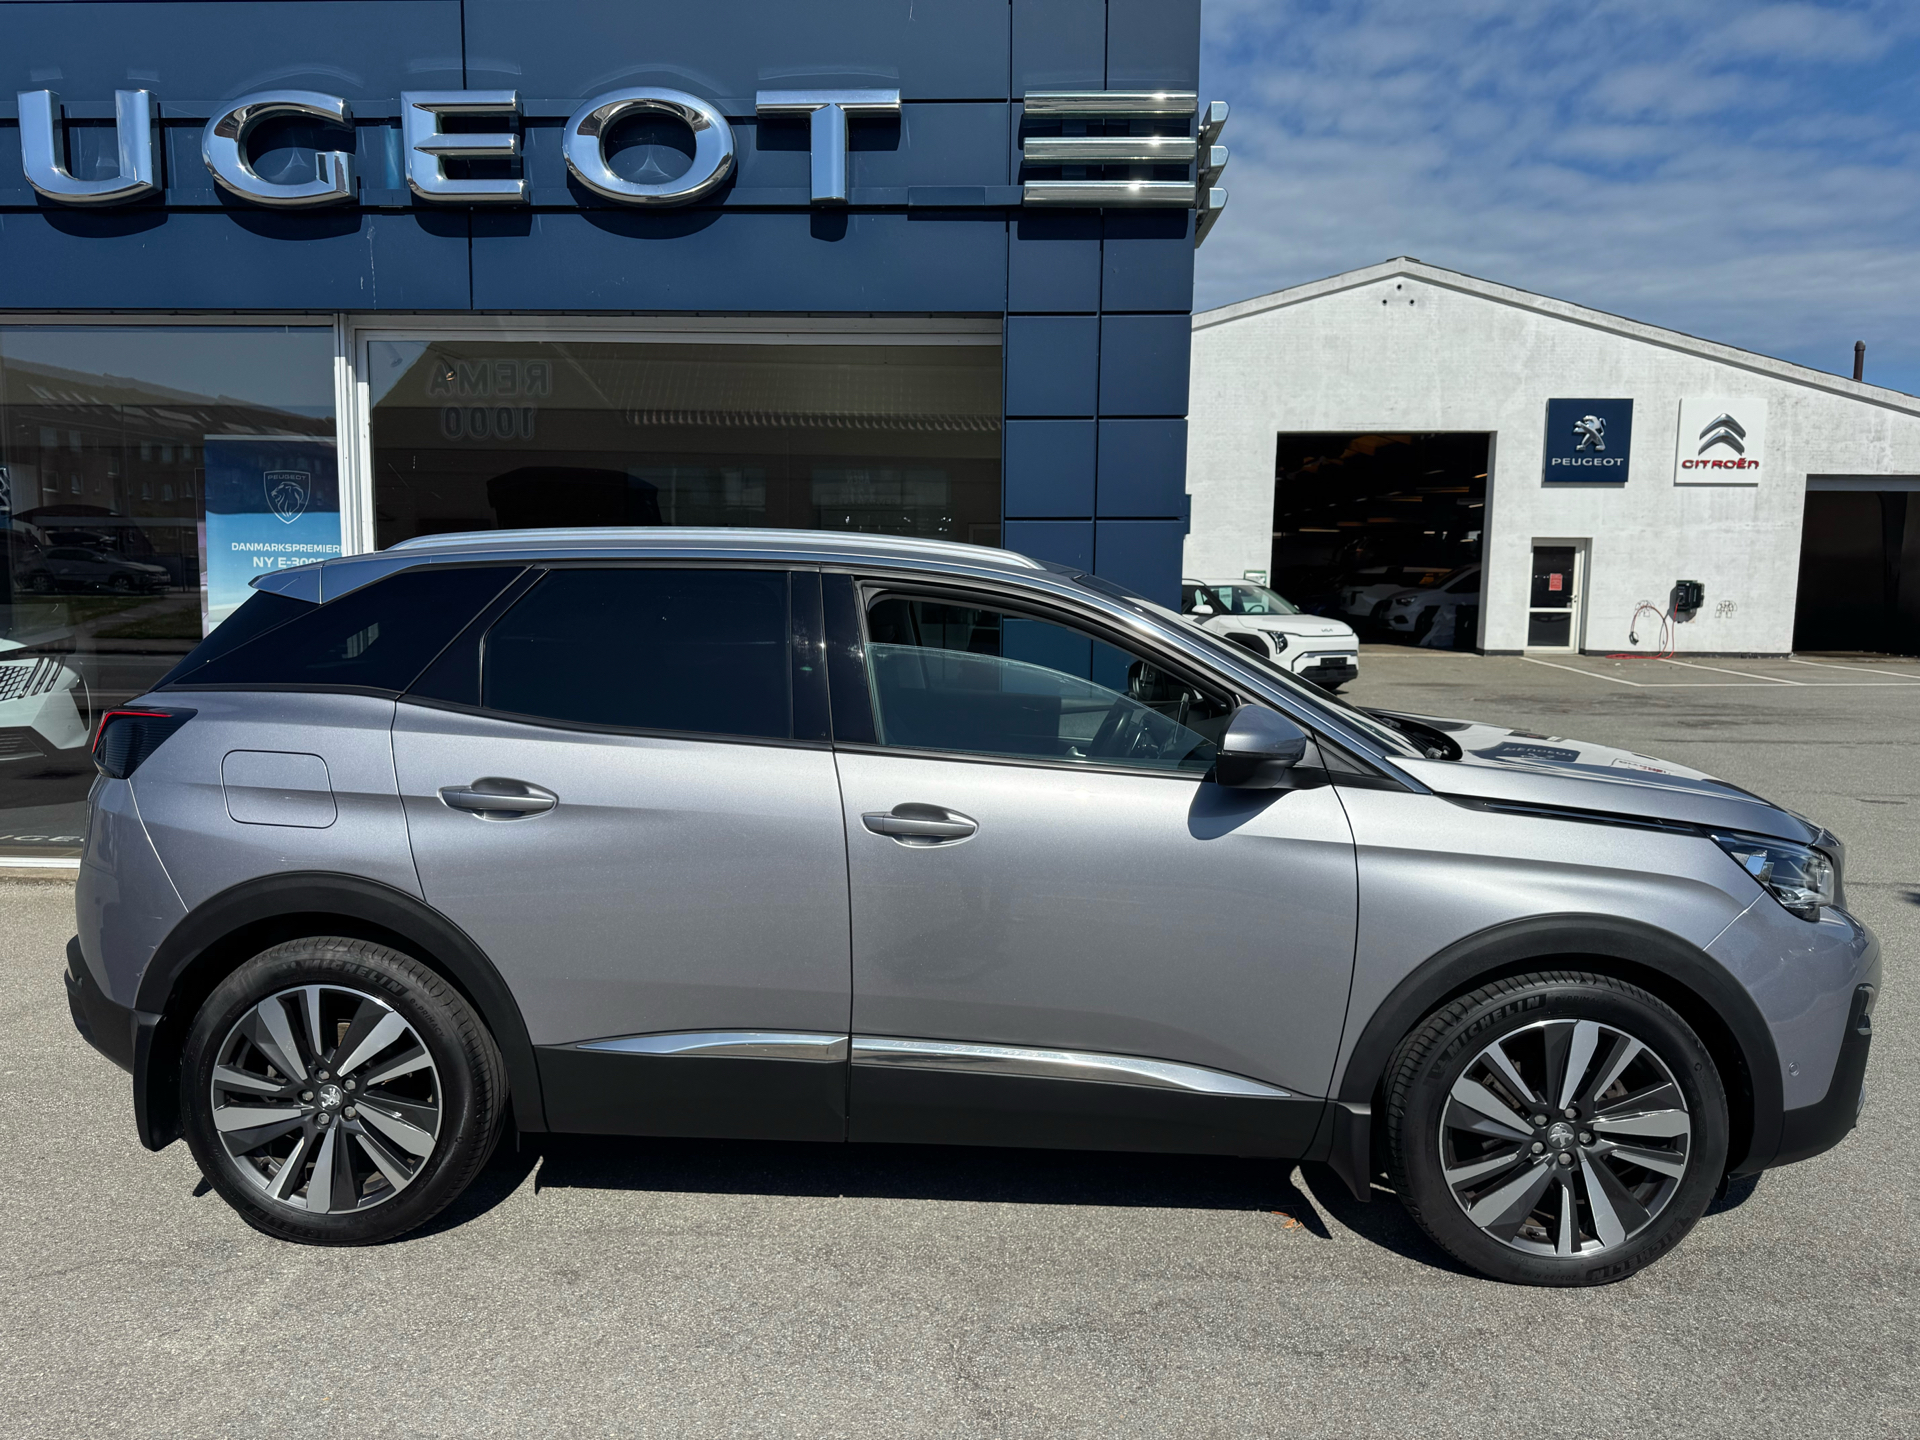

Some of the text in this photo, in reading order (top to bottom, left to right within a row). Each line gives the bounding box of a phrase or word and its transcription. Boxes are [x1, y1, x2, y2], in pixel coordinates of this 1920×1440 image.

[1551, 457, 1624, 467] PEUGEOT
[231, 543, 342, 553] DANMARKSPREMIER
[252, 556, 275, 568] NY
[304, 958, 404, 994] MICHELIN
[1446, 995, 1541, 1059] MICHELIN
[1587, 1222, 1684, 1281] MICHELIN
